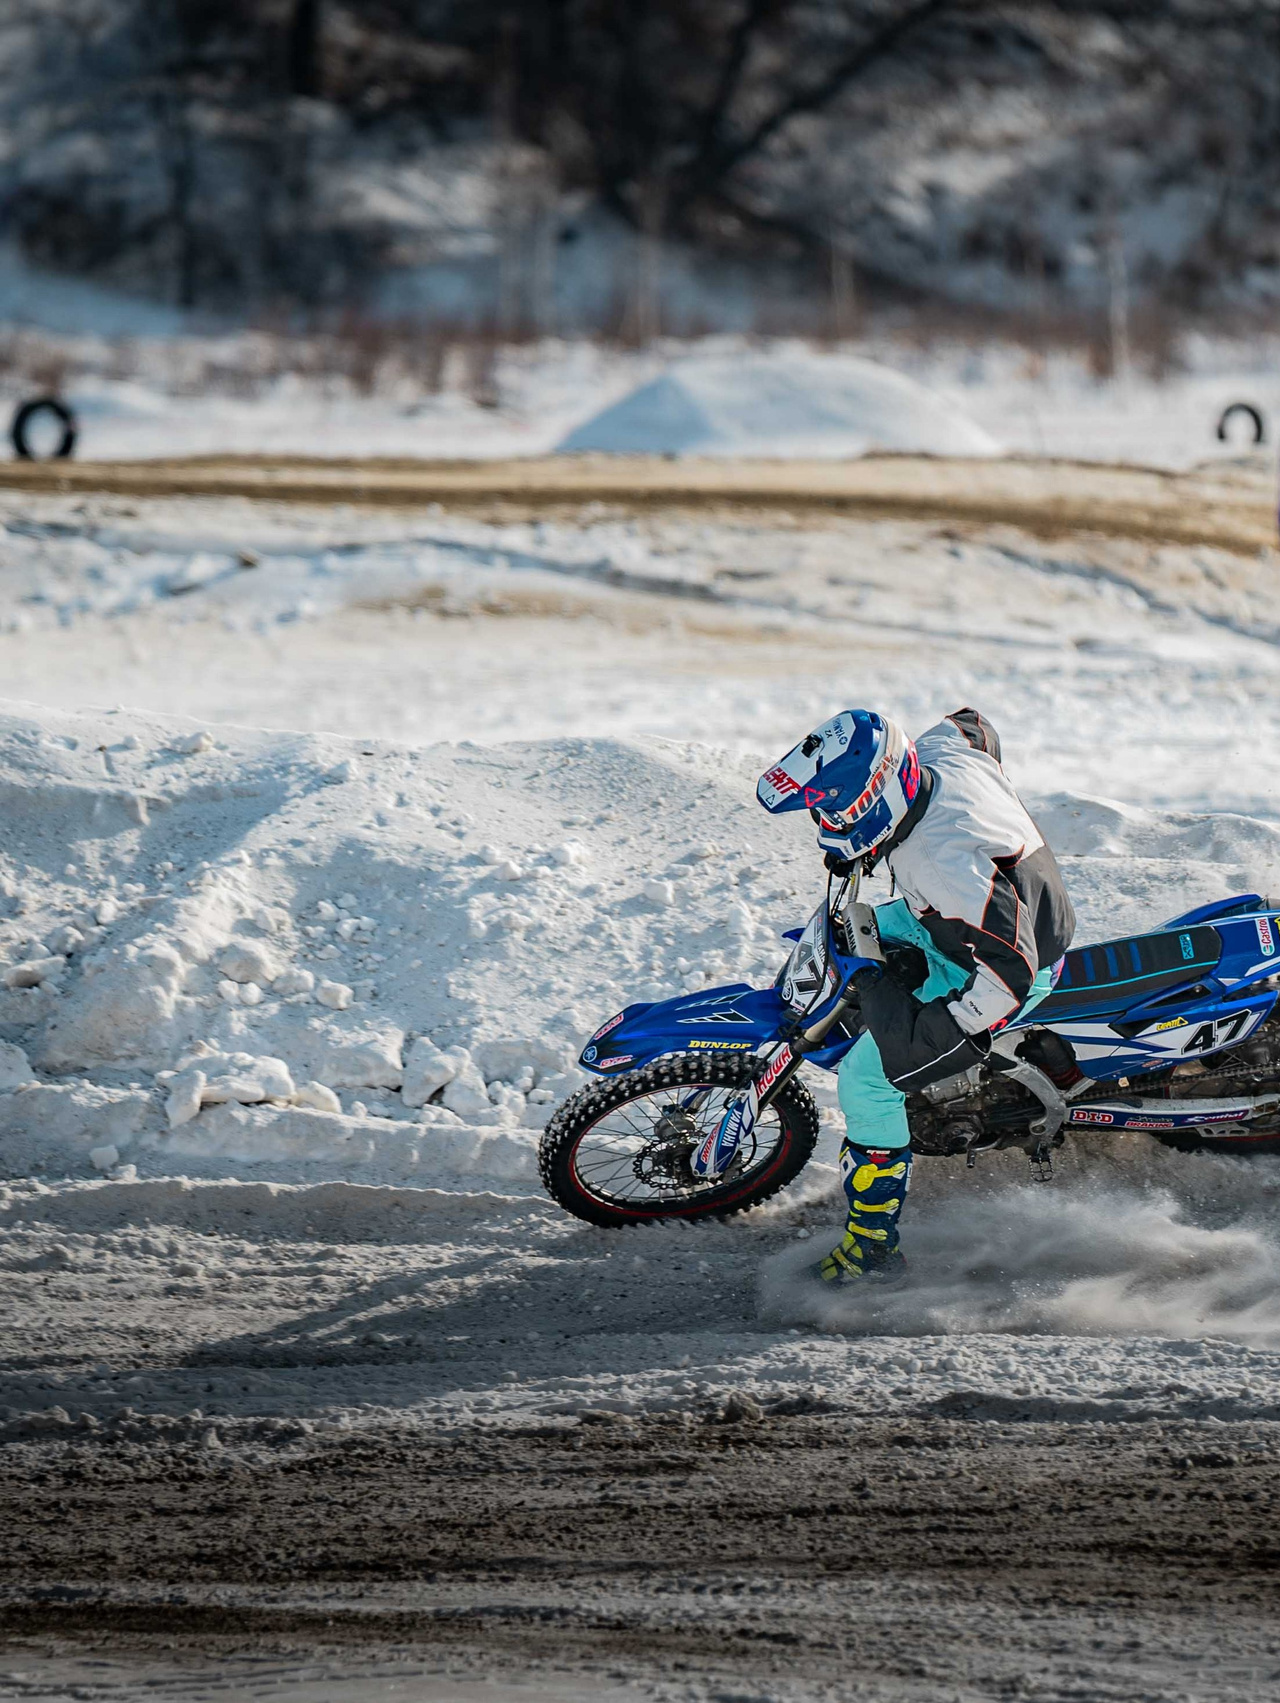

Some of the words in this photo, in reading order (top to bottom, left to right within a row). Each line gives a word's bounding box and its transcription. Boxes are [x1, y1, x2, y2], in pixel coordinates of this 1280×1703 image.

[844, 916, 857, 953] YAMAHA
[1258, 918, 1271, 945] Castrol
[688, 1040, 754, 1050] DUNLOP
[1182, 1009, 1251, 1055] 47
[722, 1109, 741, 1147] YAMAHA
